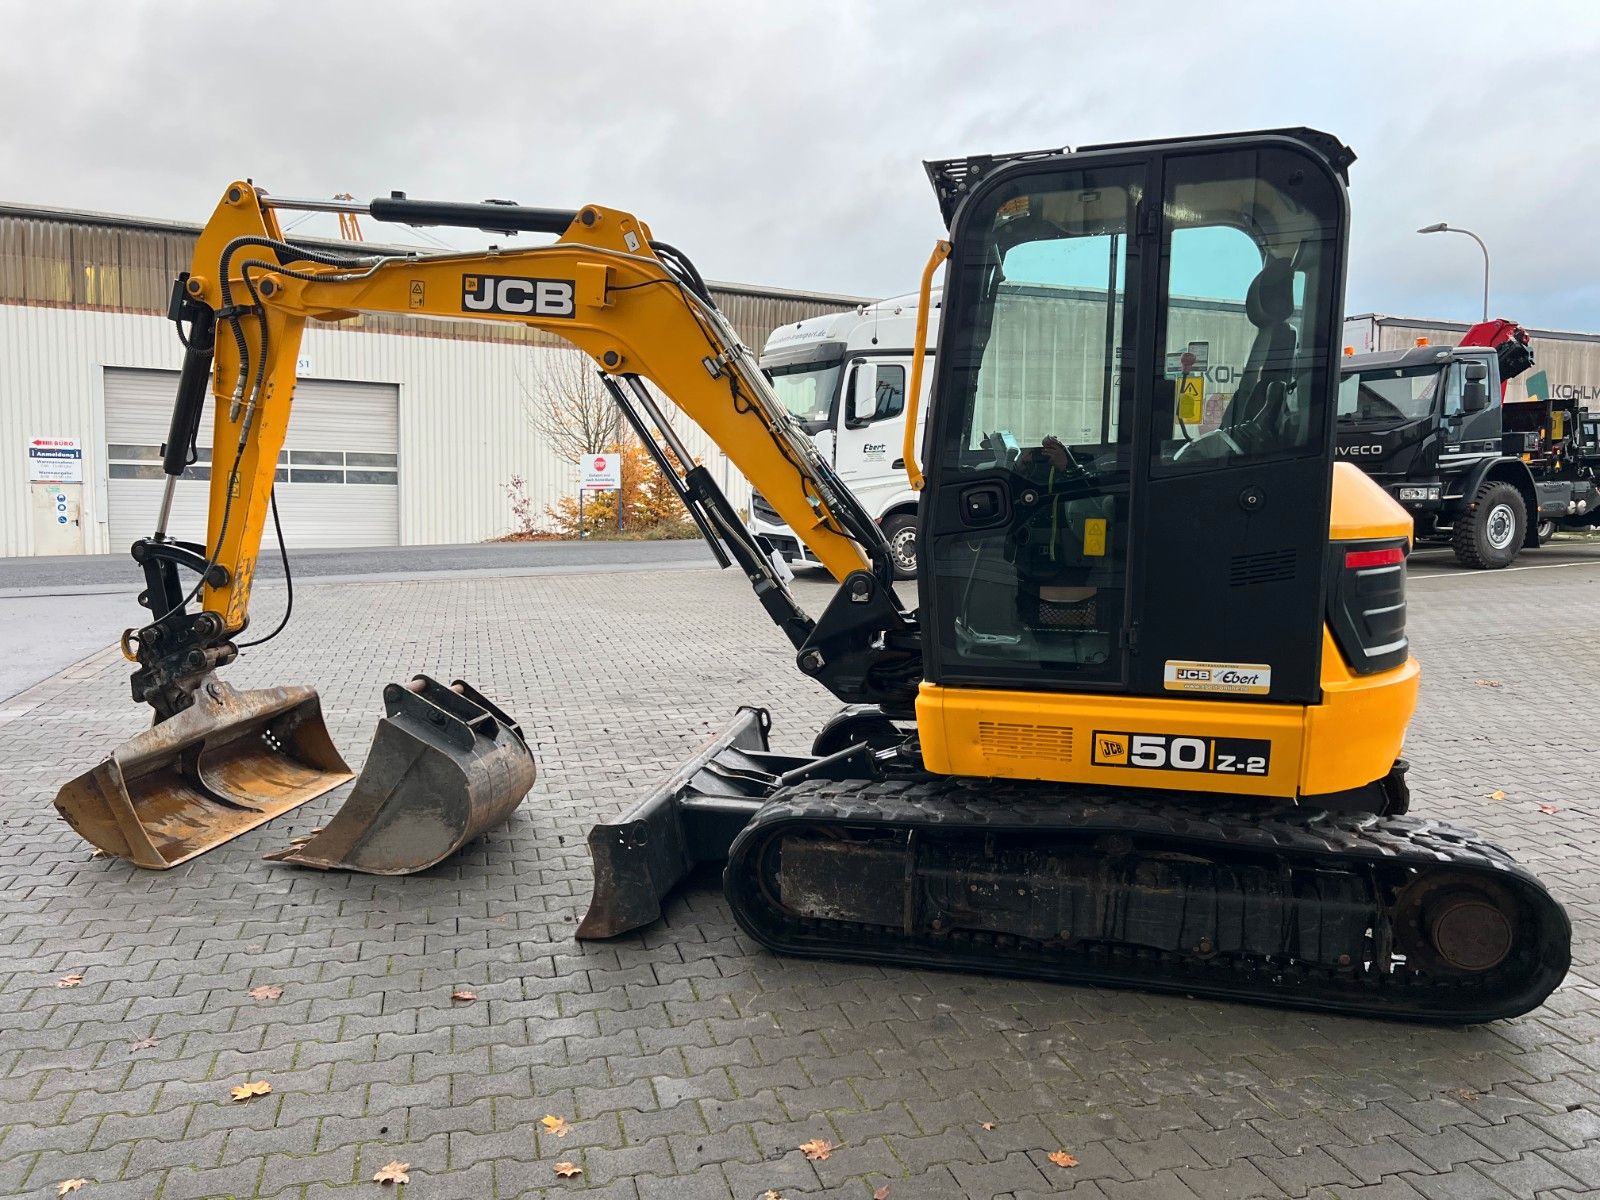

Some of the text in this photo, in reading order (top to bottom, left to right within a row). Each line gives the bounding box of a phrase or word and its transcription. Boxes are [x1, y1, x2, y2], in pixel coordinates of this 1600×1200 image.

[464, 278, 574, 315] JCB
[863, 443, 886, 453] Ebert
[1334, 445, 1383, 456] IVECO
[1178, 670, 1211, 680] JCB
[1222, 671, 1259, 685] Ebert
[1102, 735, 1266, 774] JCB 50 Z-2
